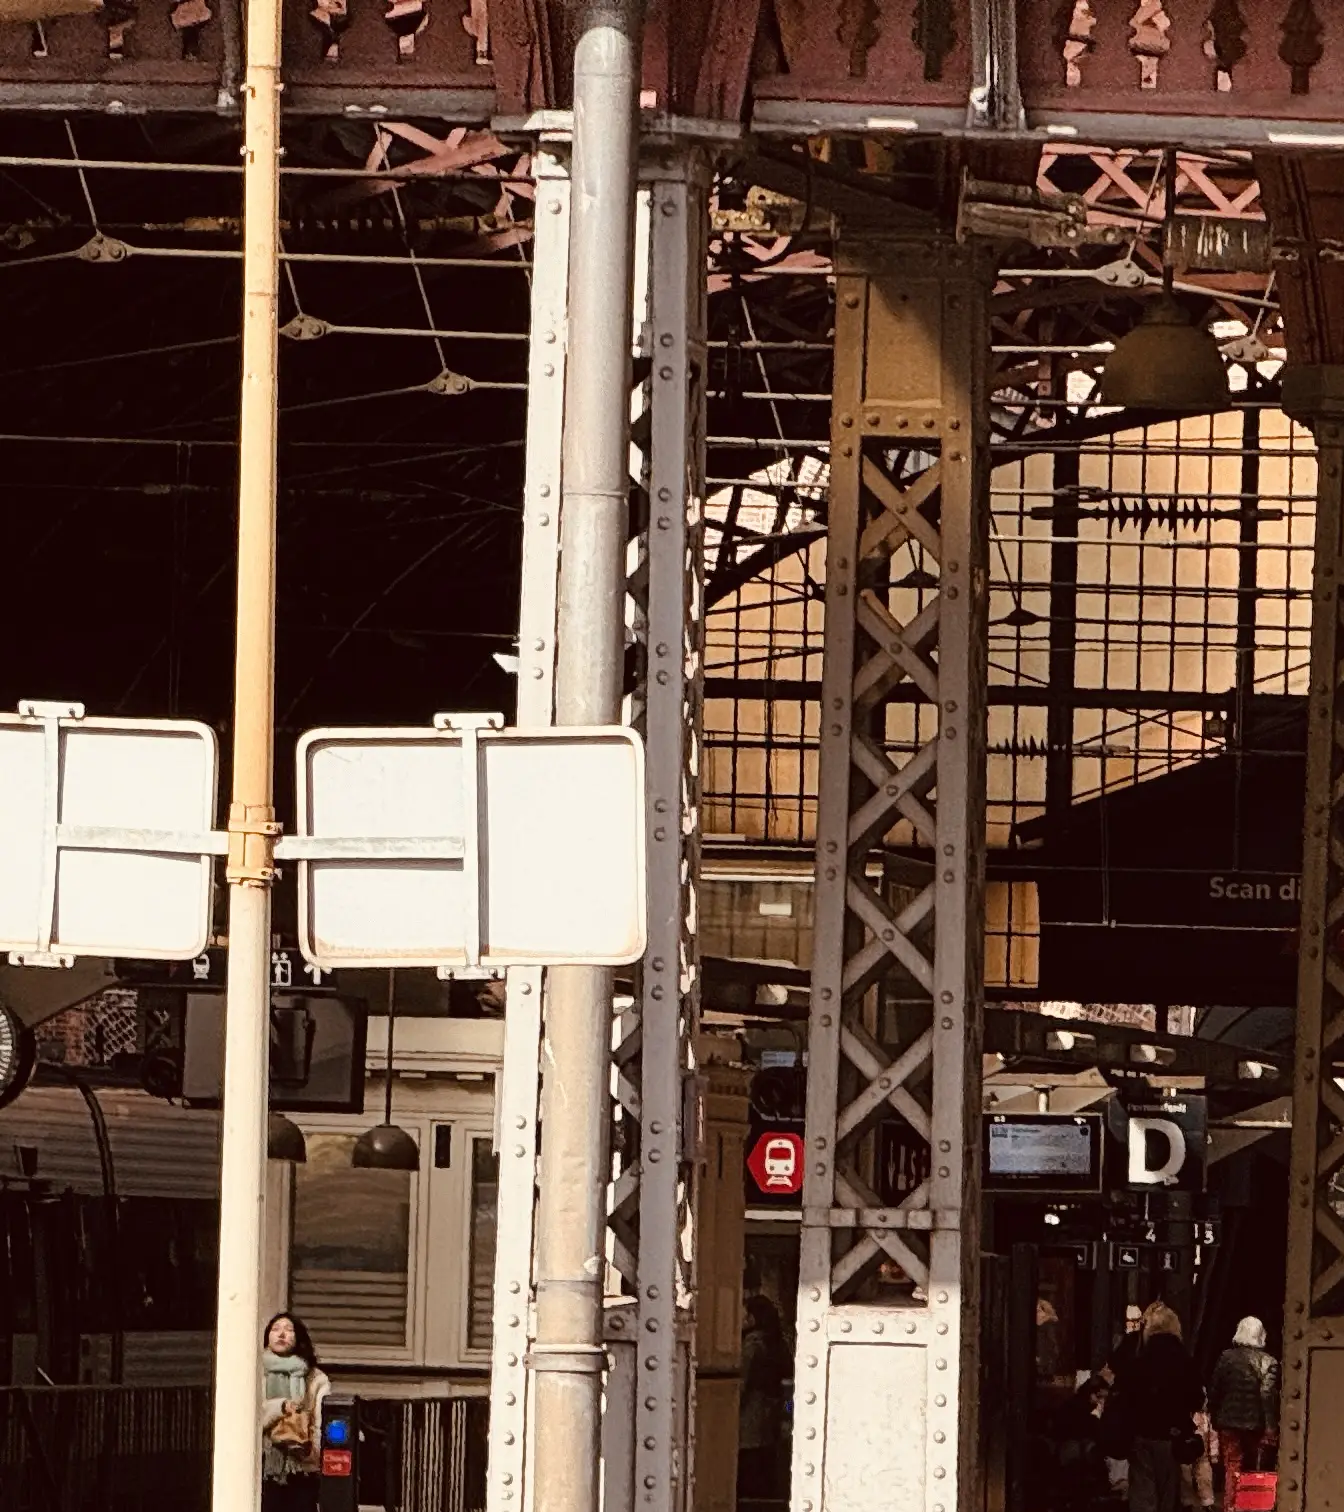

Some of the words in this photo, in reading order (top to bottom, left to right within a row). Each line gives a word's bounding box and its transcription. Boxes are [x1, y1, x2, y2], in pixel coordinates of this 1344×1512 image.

[1209, 876, 1271, 900] Scan
[1276, 874, 1300, 901] di
[1128, 1117, 1186, 1184] D
